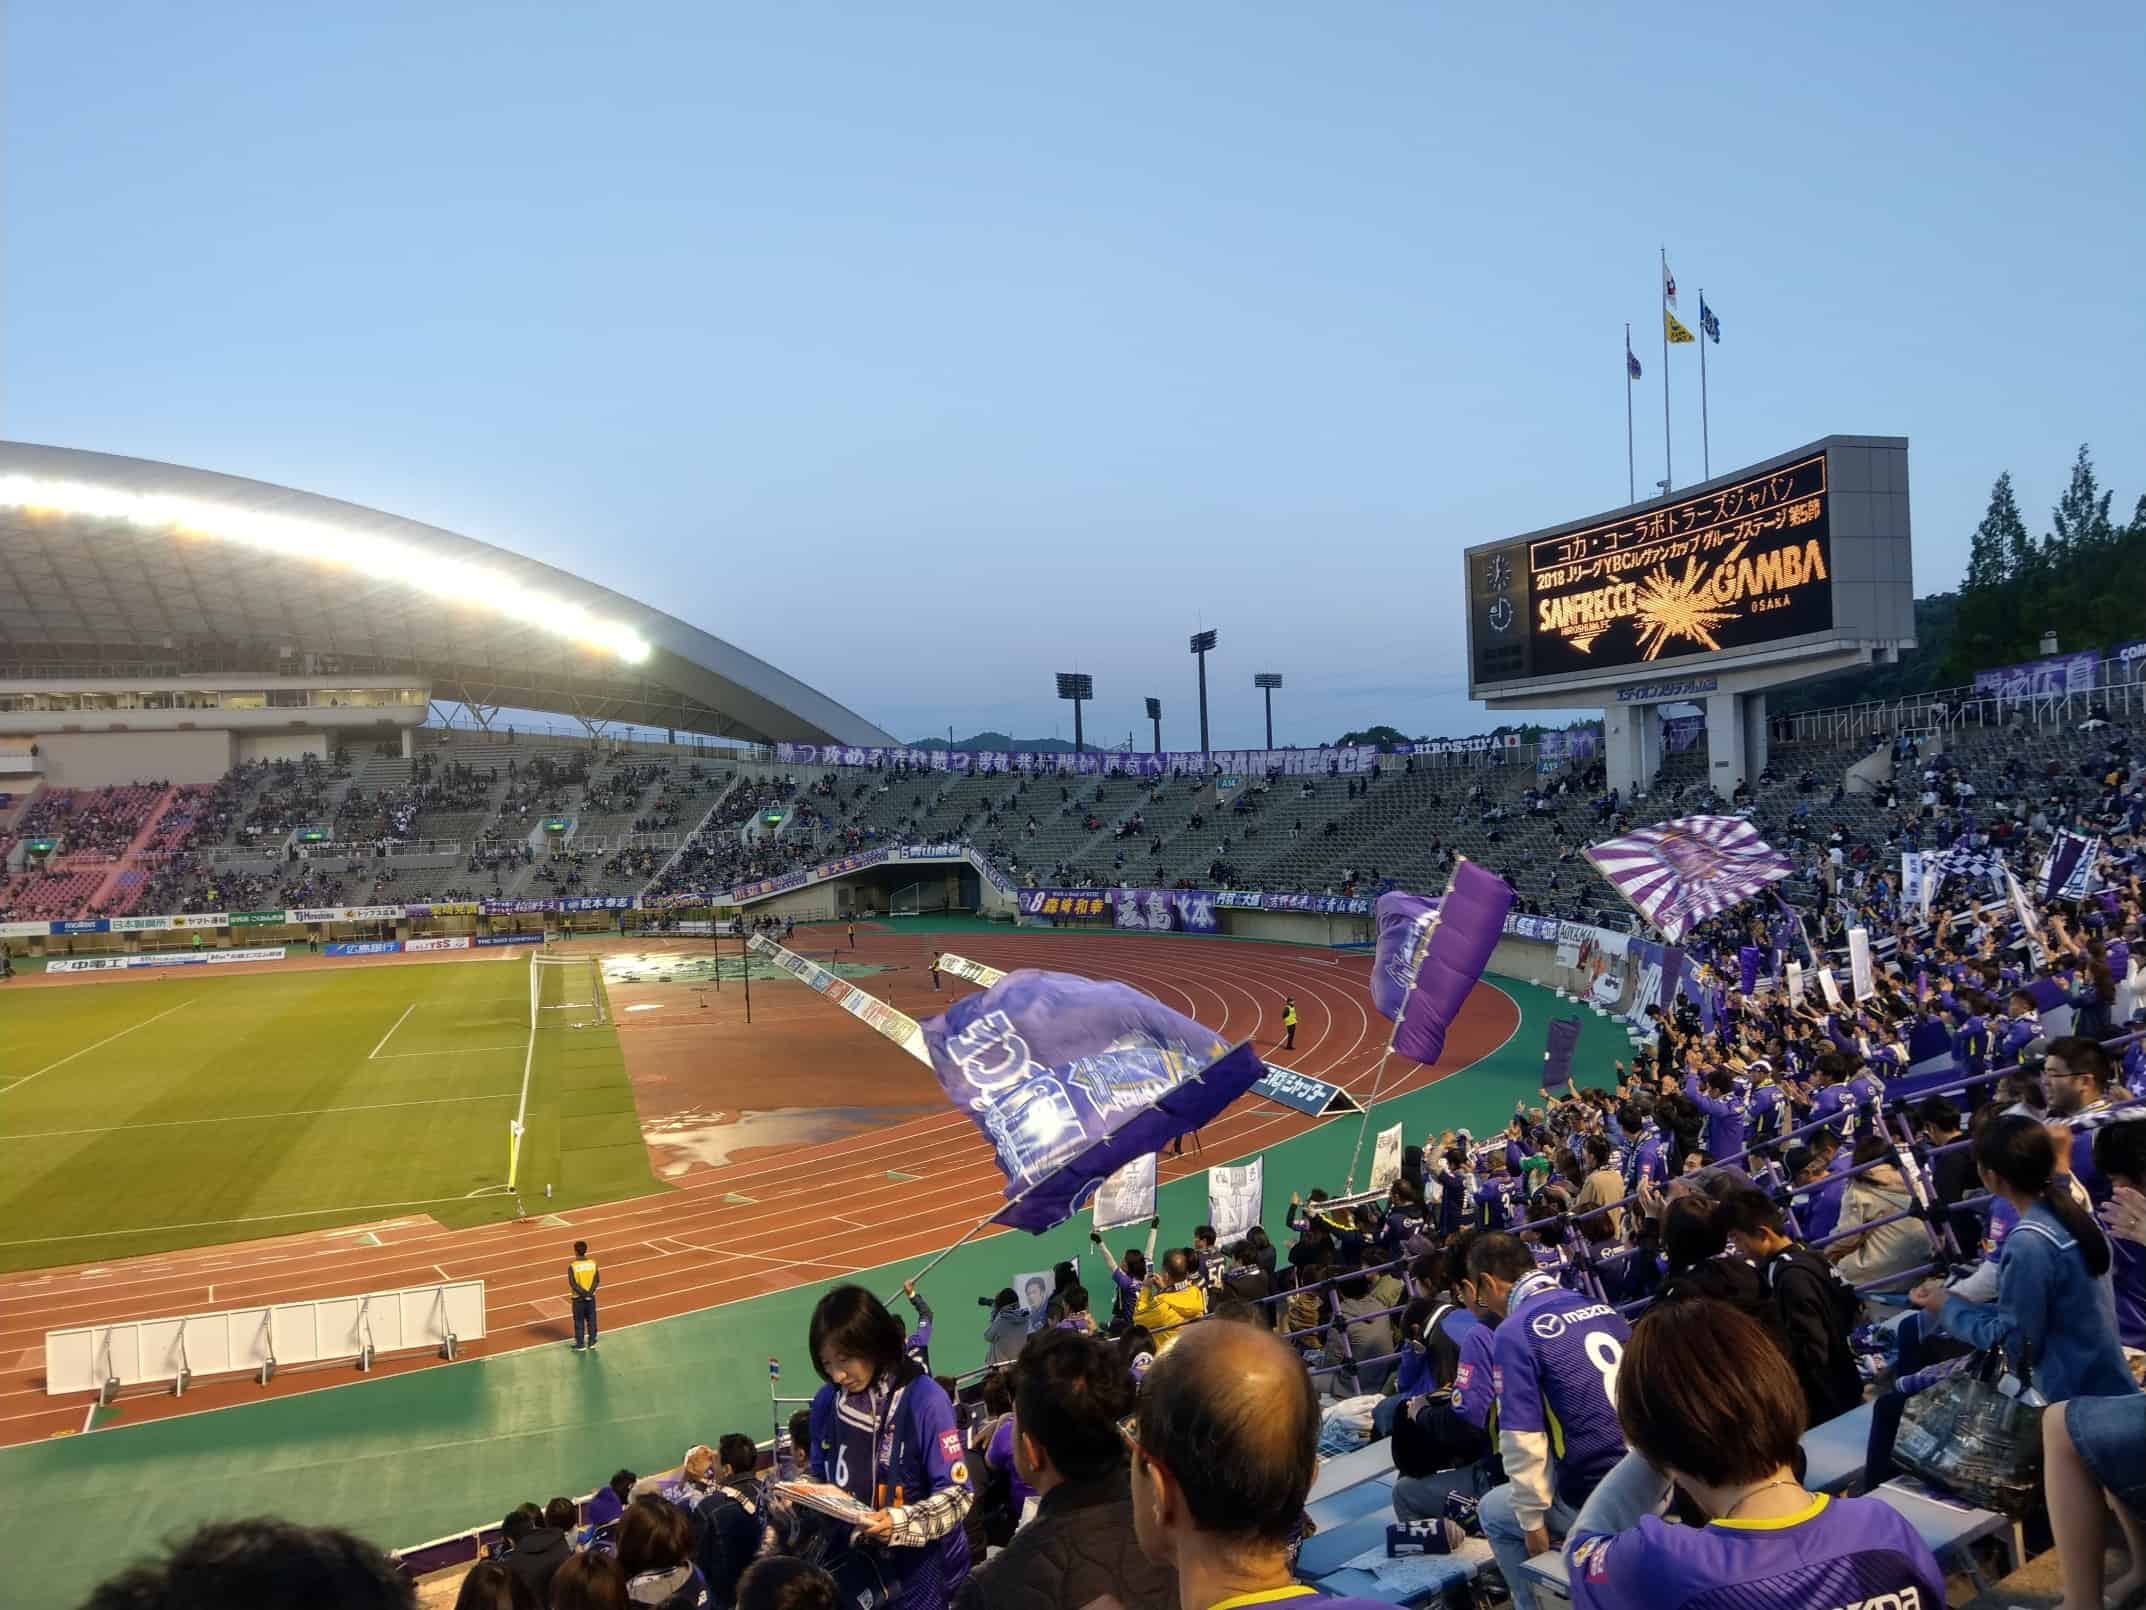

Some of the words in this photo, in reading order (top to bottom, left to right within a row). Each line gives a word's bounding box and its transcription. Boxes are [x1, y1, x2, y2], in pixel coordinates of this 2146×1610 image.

[1557, 476, 1794, 562] コカ・コーラボトラーズジャパン
[1536, 570, 1565, 591] 2018
[1712, 540, 1827, 604] GAMBA
[1538, 581, 1637, 632] SANFRECCE
[1751, 595, 1791, 614] OSAKA
[1029, 891, 1046, 913] 8
